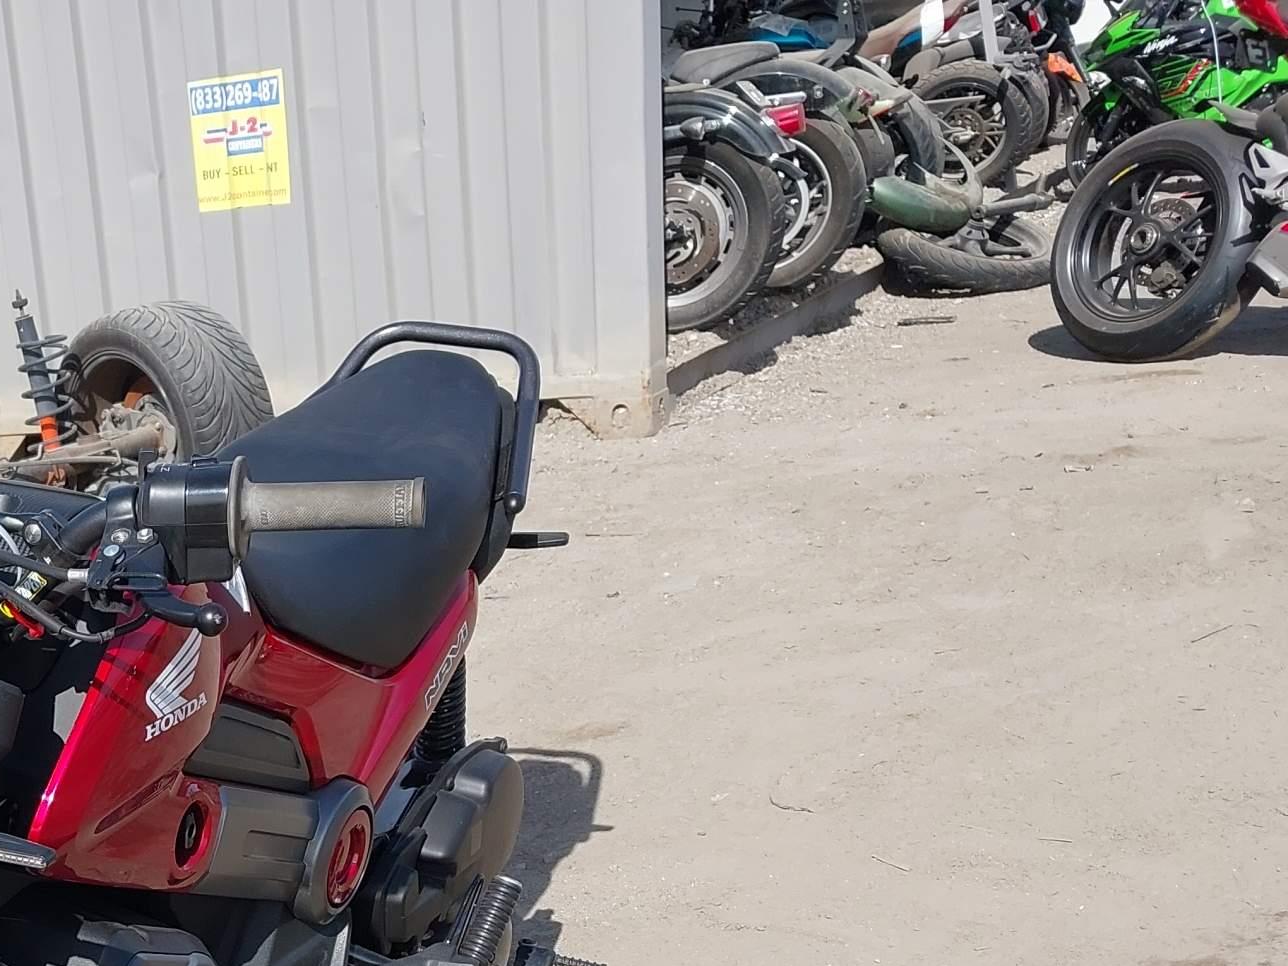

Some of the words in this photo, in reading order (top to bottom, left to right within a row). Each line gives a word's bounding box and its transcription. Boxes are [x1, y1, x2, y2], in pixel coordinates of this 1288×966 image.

[202, 168, 221, 180] BUY
[232, 164, 256, 176] SELL
[145, 692, 208, 741] HONDA
